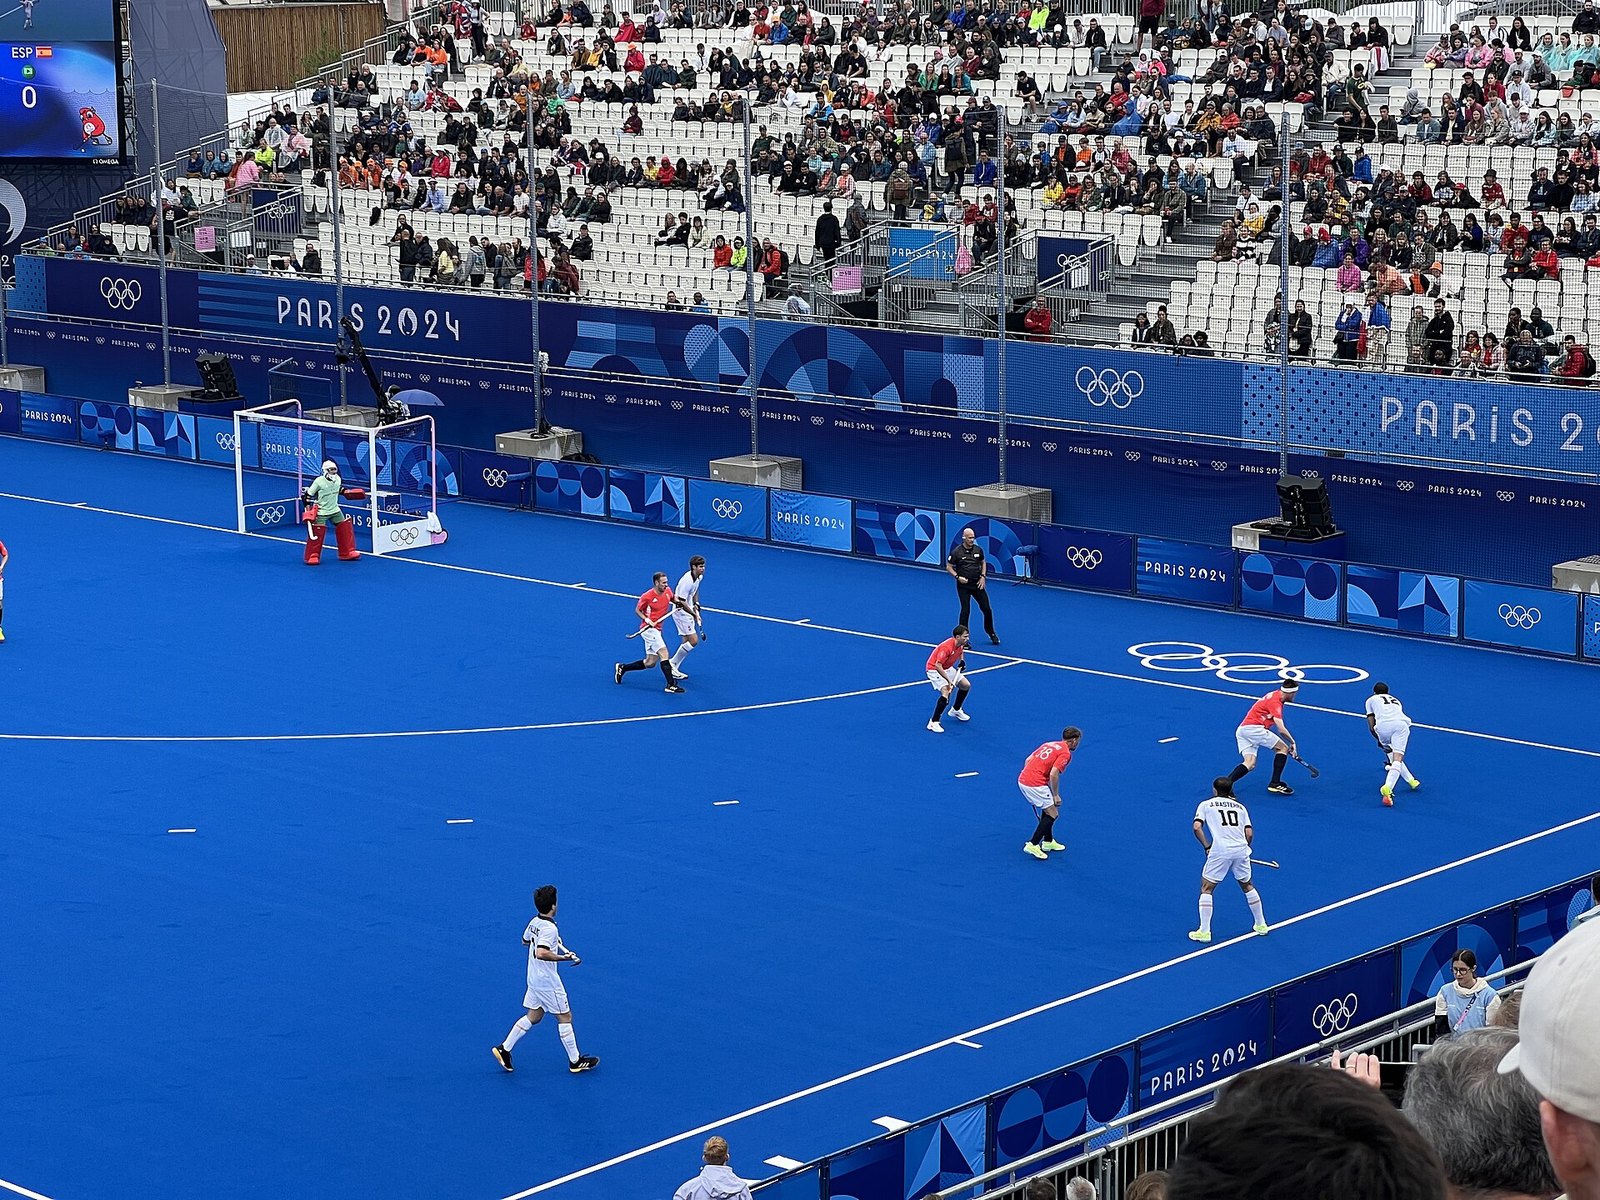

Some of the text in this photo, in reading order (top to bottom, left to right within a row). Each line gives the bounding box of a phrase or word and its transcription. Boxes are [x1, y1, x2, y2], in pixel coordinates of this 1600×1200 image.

[12, 47, 33, 58] ESP
[22, 86, 37, 108] 0
[277, 296, 460, 341] PARS 2024
[50, 413, 72, 424] 2024
[1457, 488, 1482, 497] 2024
[1560, 498, 1586, 508] 2024
[814, 516, 845, 530] 2024
[1189, 567, 1226, 582] 2024
[1218, 809, 1239, 826] 10
[1211, 1039, 1258, 1074] 2024
